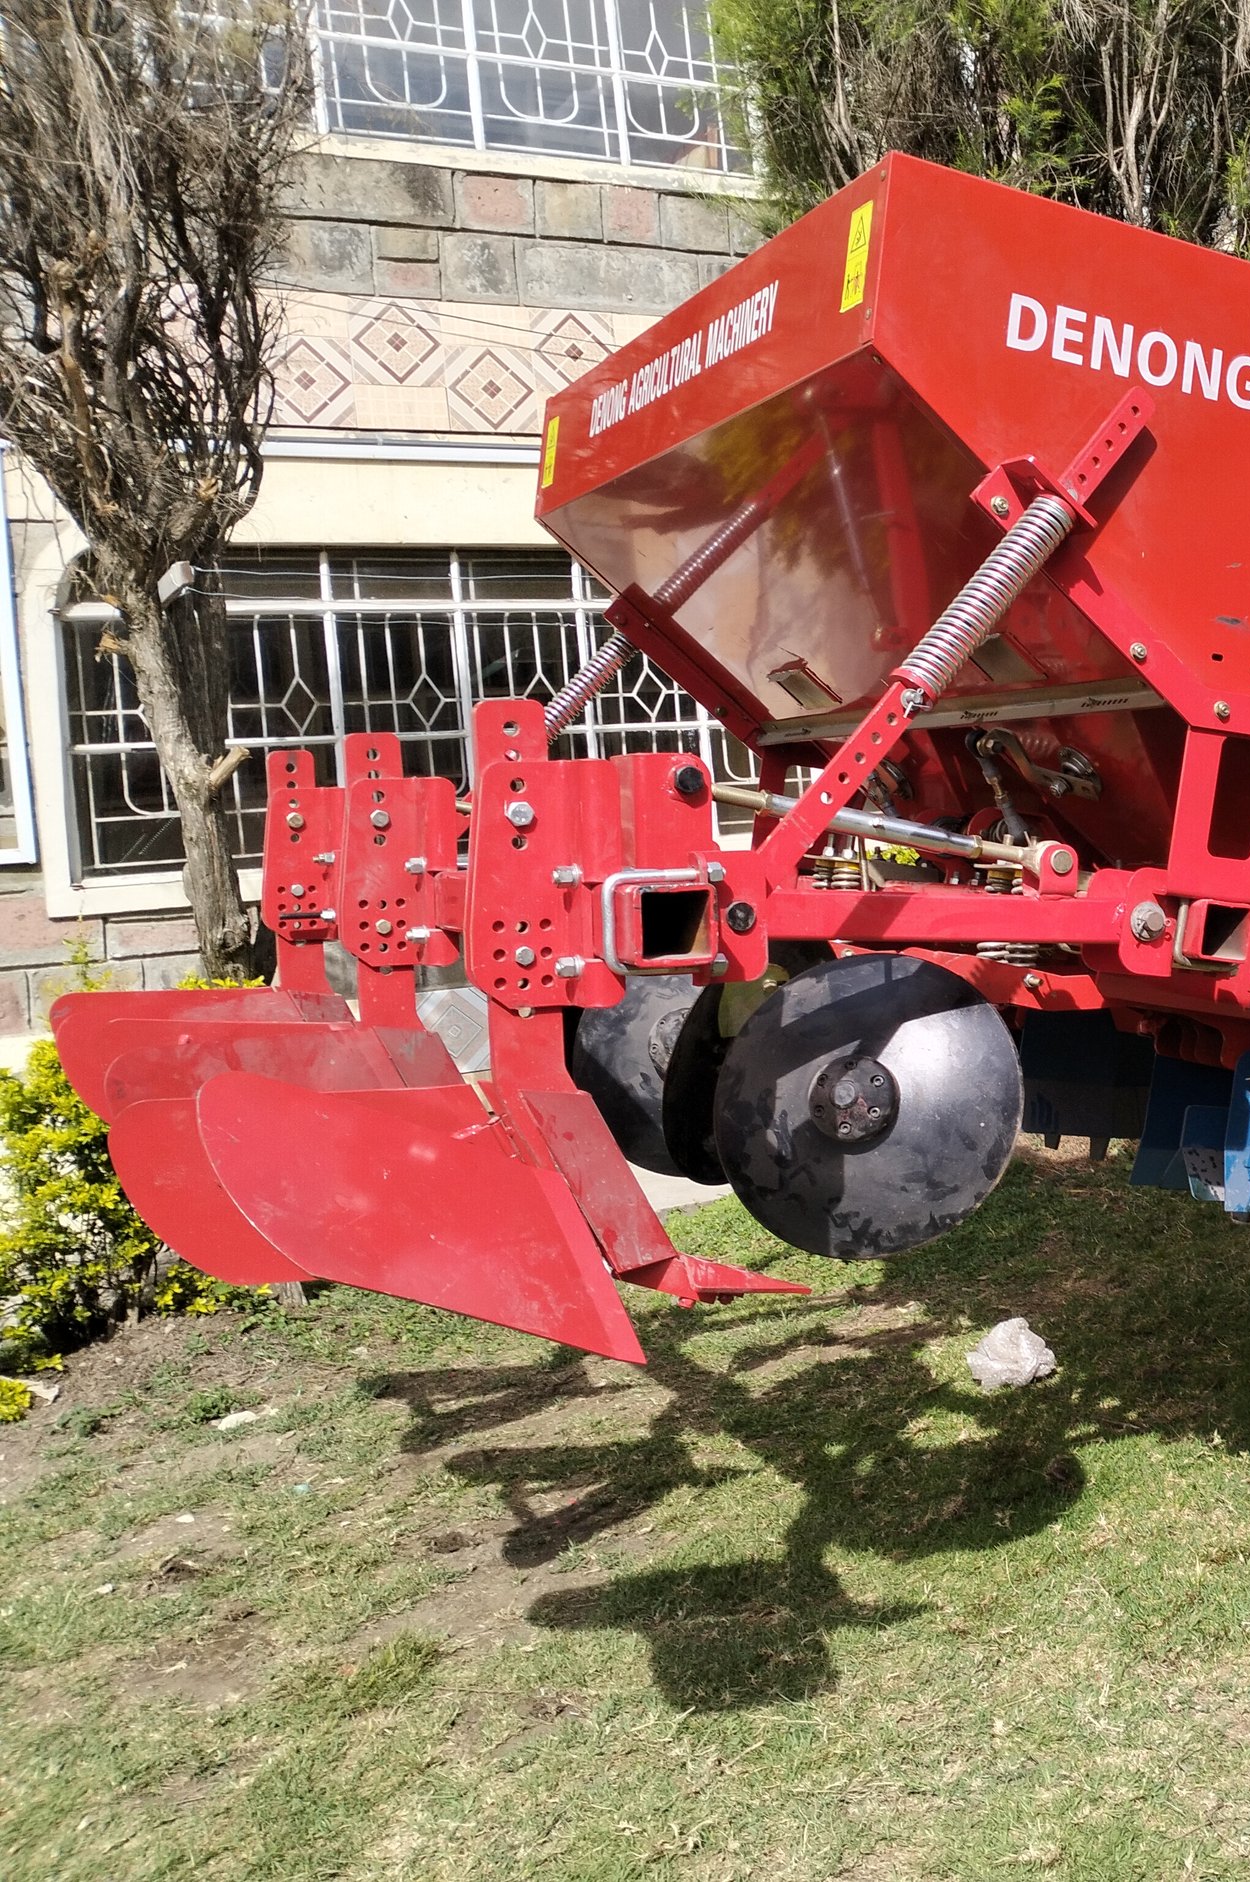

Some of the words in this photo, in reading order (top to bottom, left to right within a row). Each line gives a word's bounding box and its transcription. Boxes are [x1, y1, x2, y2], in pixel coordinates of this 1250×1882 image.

[589, 379, 628, 438] DENONG
[628, 330, 702, 415] AGRICULTURAL
[705, 280, 779, 369] MACHINERY
